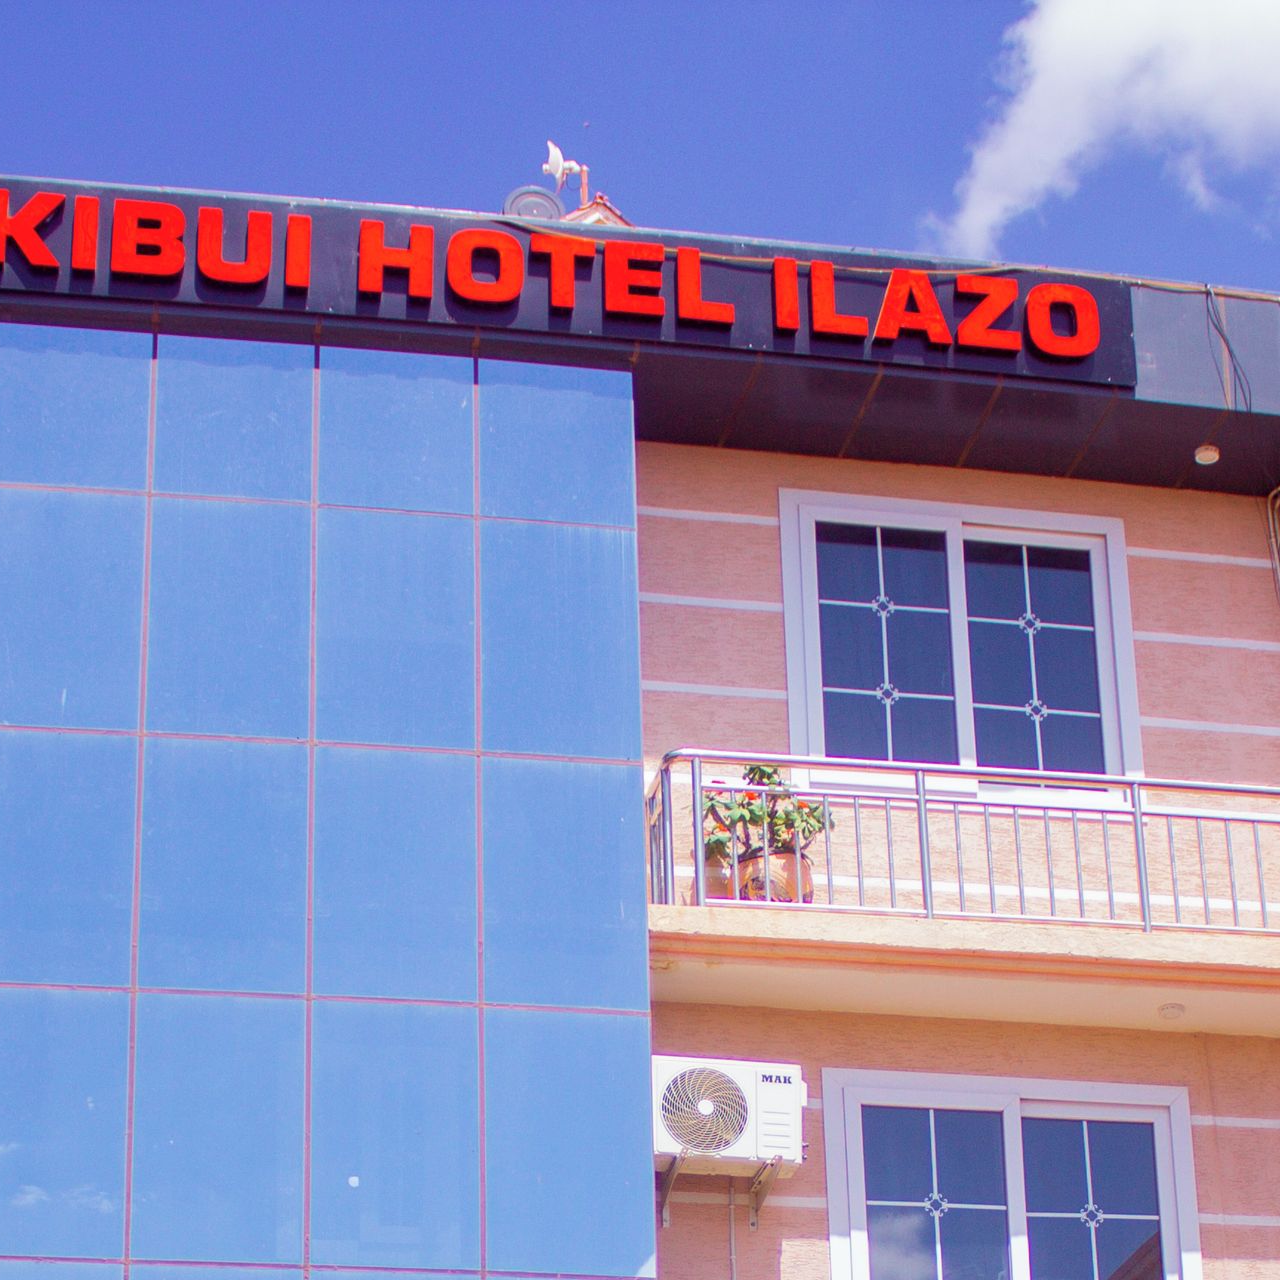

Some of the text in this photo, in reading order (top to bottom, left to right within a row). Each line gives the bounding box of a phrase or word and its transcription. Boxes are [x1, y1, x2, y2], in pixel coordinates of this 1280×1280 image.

[357, 218, 736, 324] HOTEL
[772, 256, 1102, 358] ILAZO
[761, 1074, 793, 1085] MAK
